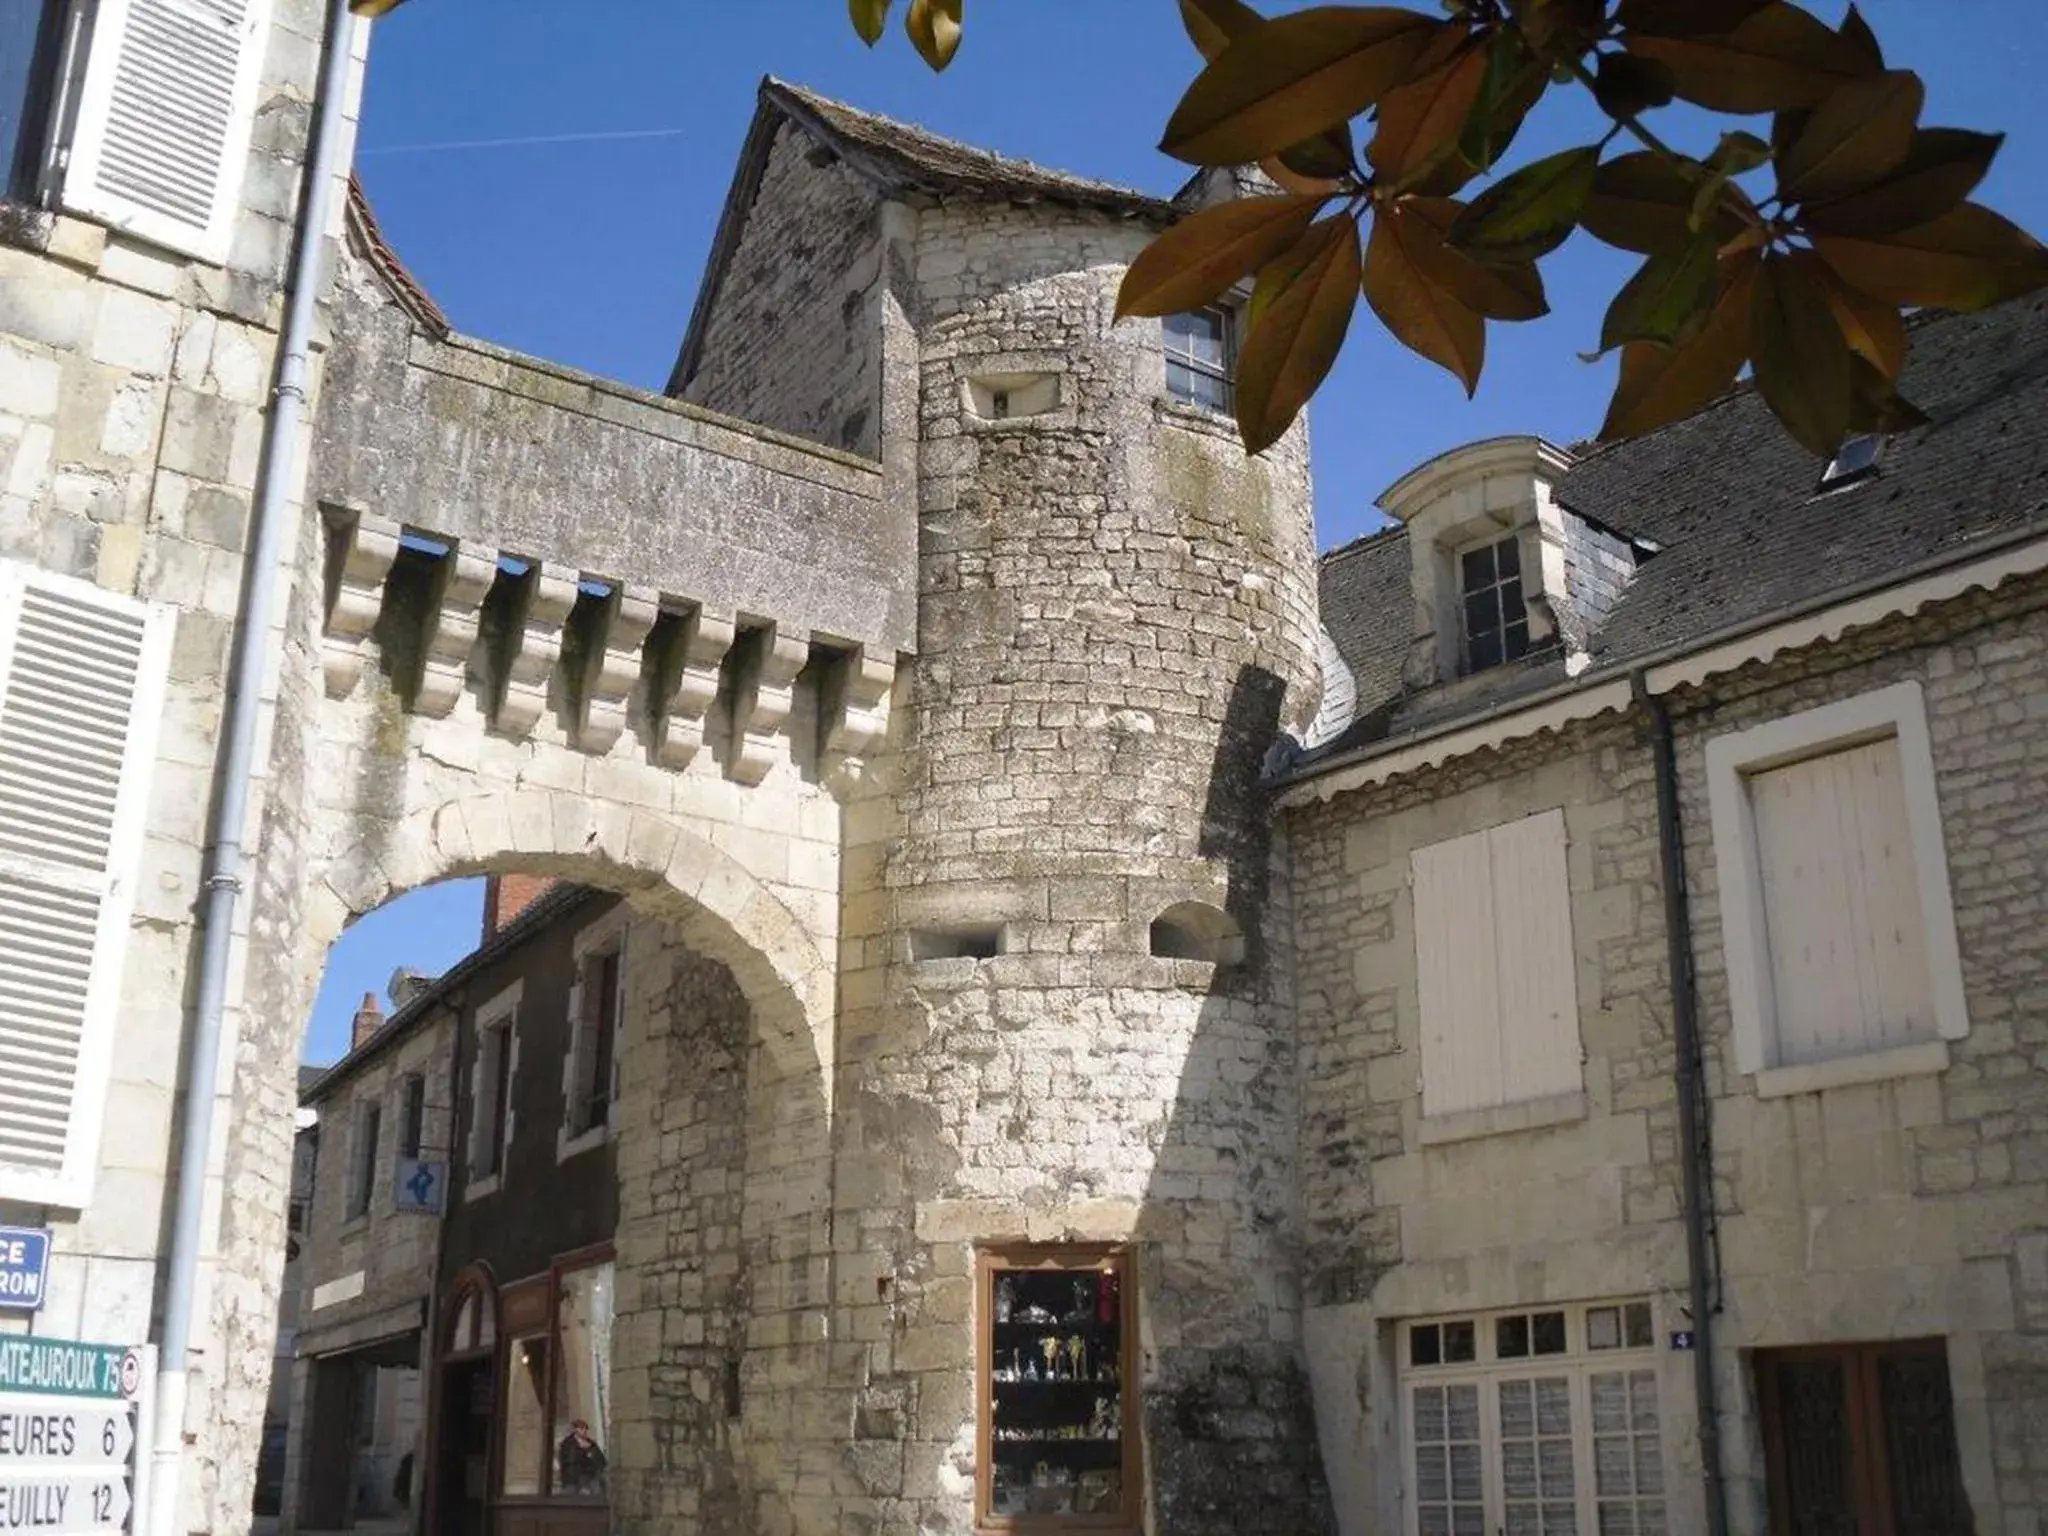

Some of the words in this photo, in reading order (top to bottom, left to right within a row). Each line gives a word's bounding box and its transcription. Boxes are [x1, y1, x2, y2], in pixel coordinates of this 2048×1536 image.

[0, 1340, 97, 1390] ATEAUROUX
[102, 1352, 120, 1393] 75
[0, 1414, 76, 1456] EURES
[102, 1417, 115, 1456] 6
[92, 1483, 111, 1524] 12
